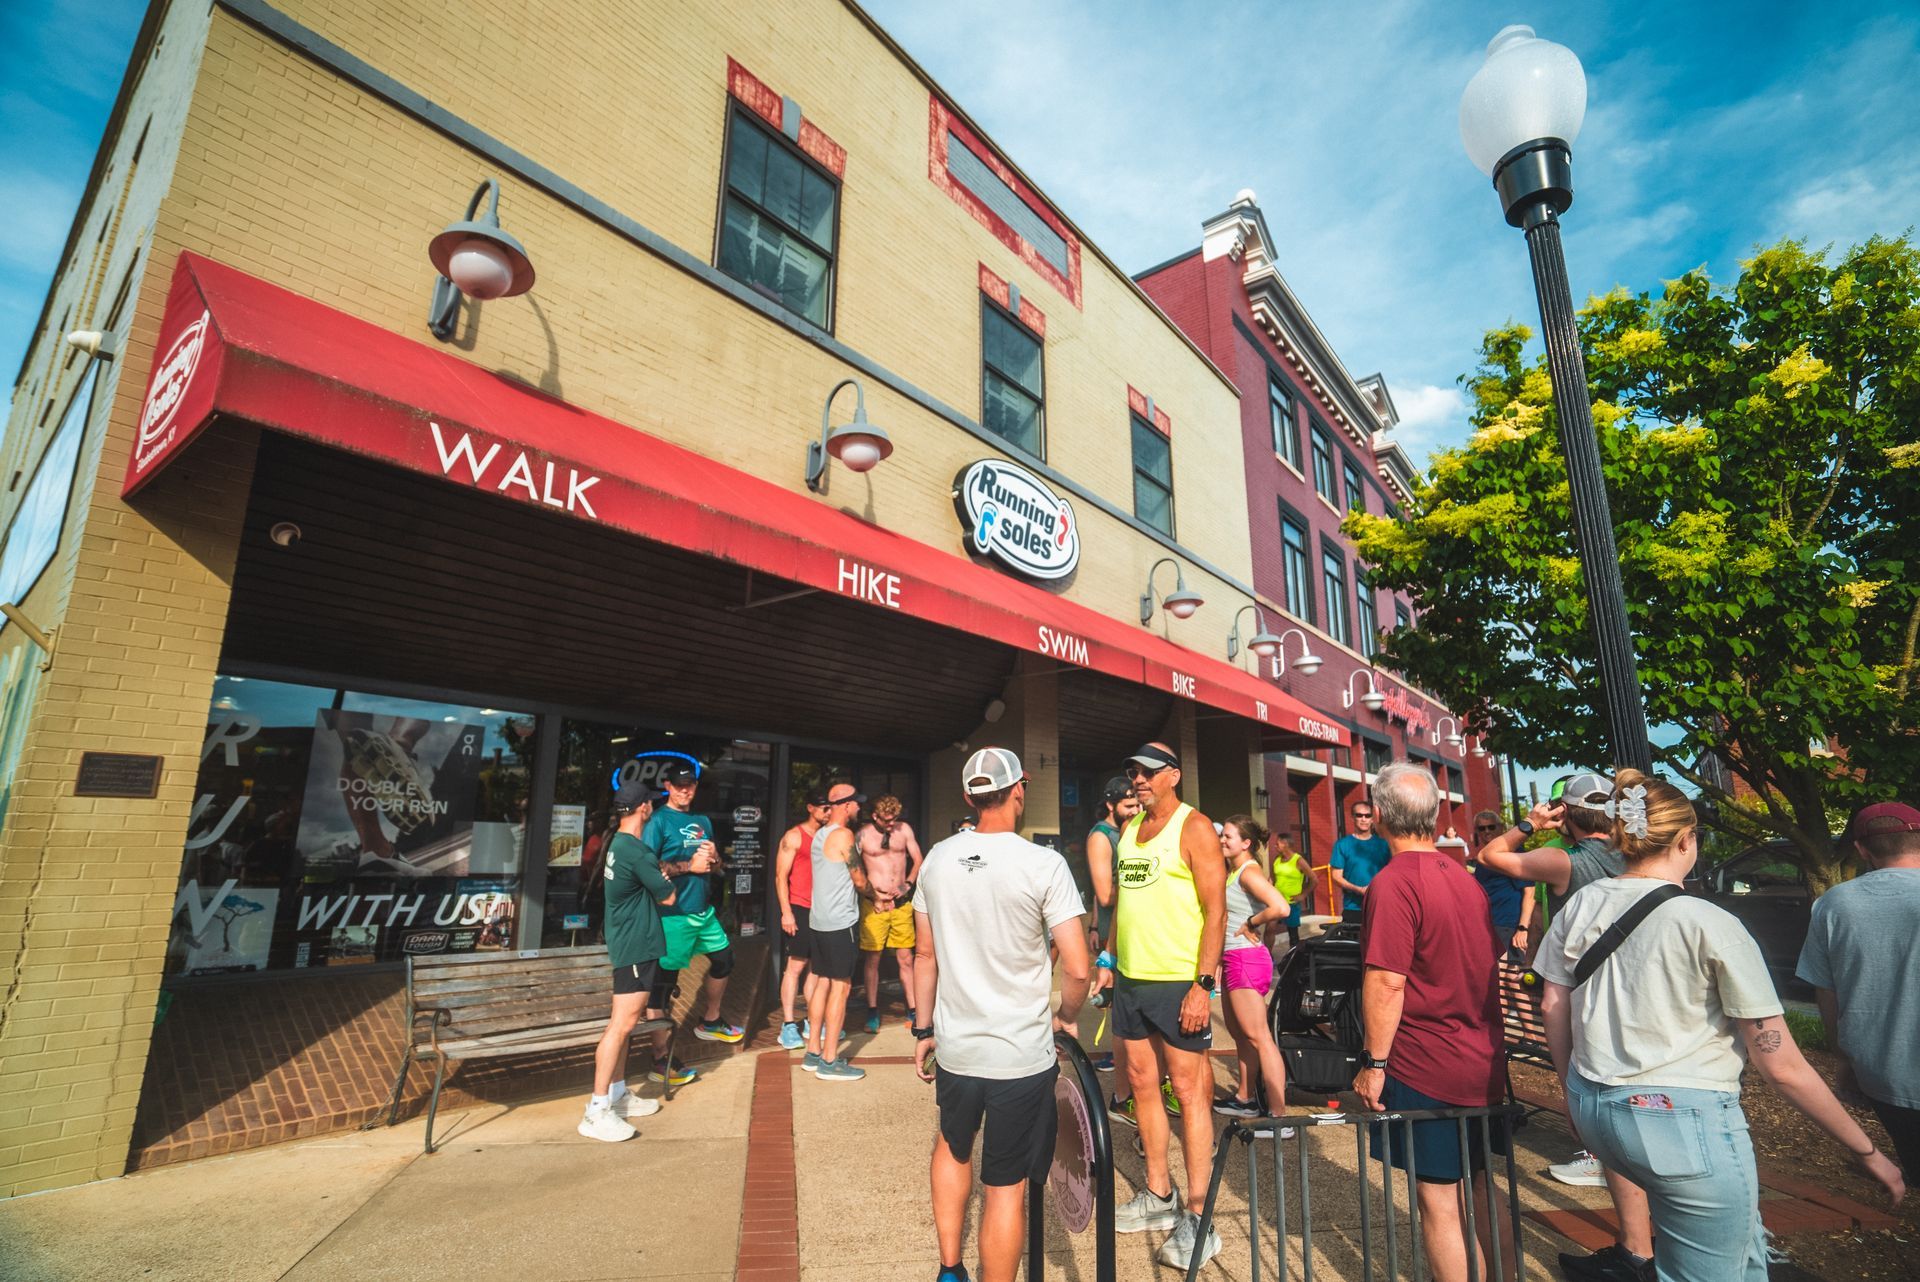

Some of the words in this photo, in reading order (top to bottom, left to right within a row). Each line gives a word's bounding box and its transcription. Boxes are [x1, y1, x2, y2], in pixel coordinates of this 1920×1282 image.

[430, 422, 600, 518] WALK
[977, 464, 1055, 535] Running
[1000, 518, 1052, 560] soles
[838, 559, 900, 608] HIKE
[1039, 626, 1089, 665] SWIM
[1172, 672, 1195, 698] BIKE
[1256, 701, 1268, 721] TRI
[1299, 716, 1339, 742] CROSS-TRAIN
[336, 777, 417, 796] DOUBLE
[619, 759, 673, 788] OPE
[351, 796, 404, 813] YOUR
[409, 799, 448, 814] RUN
[1119, 860, 1149, 872] Running
[1124, 871, 1147, 882] soles
[296, 894, 425, 931] WITH
[433, 892, 504, 925] US!
